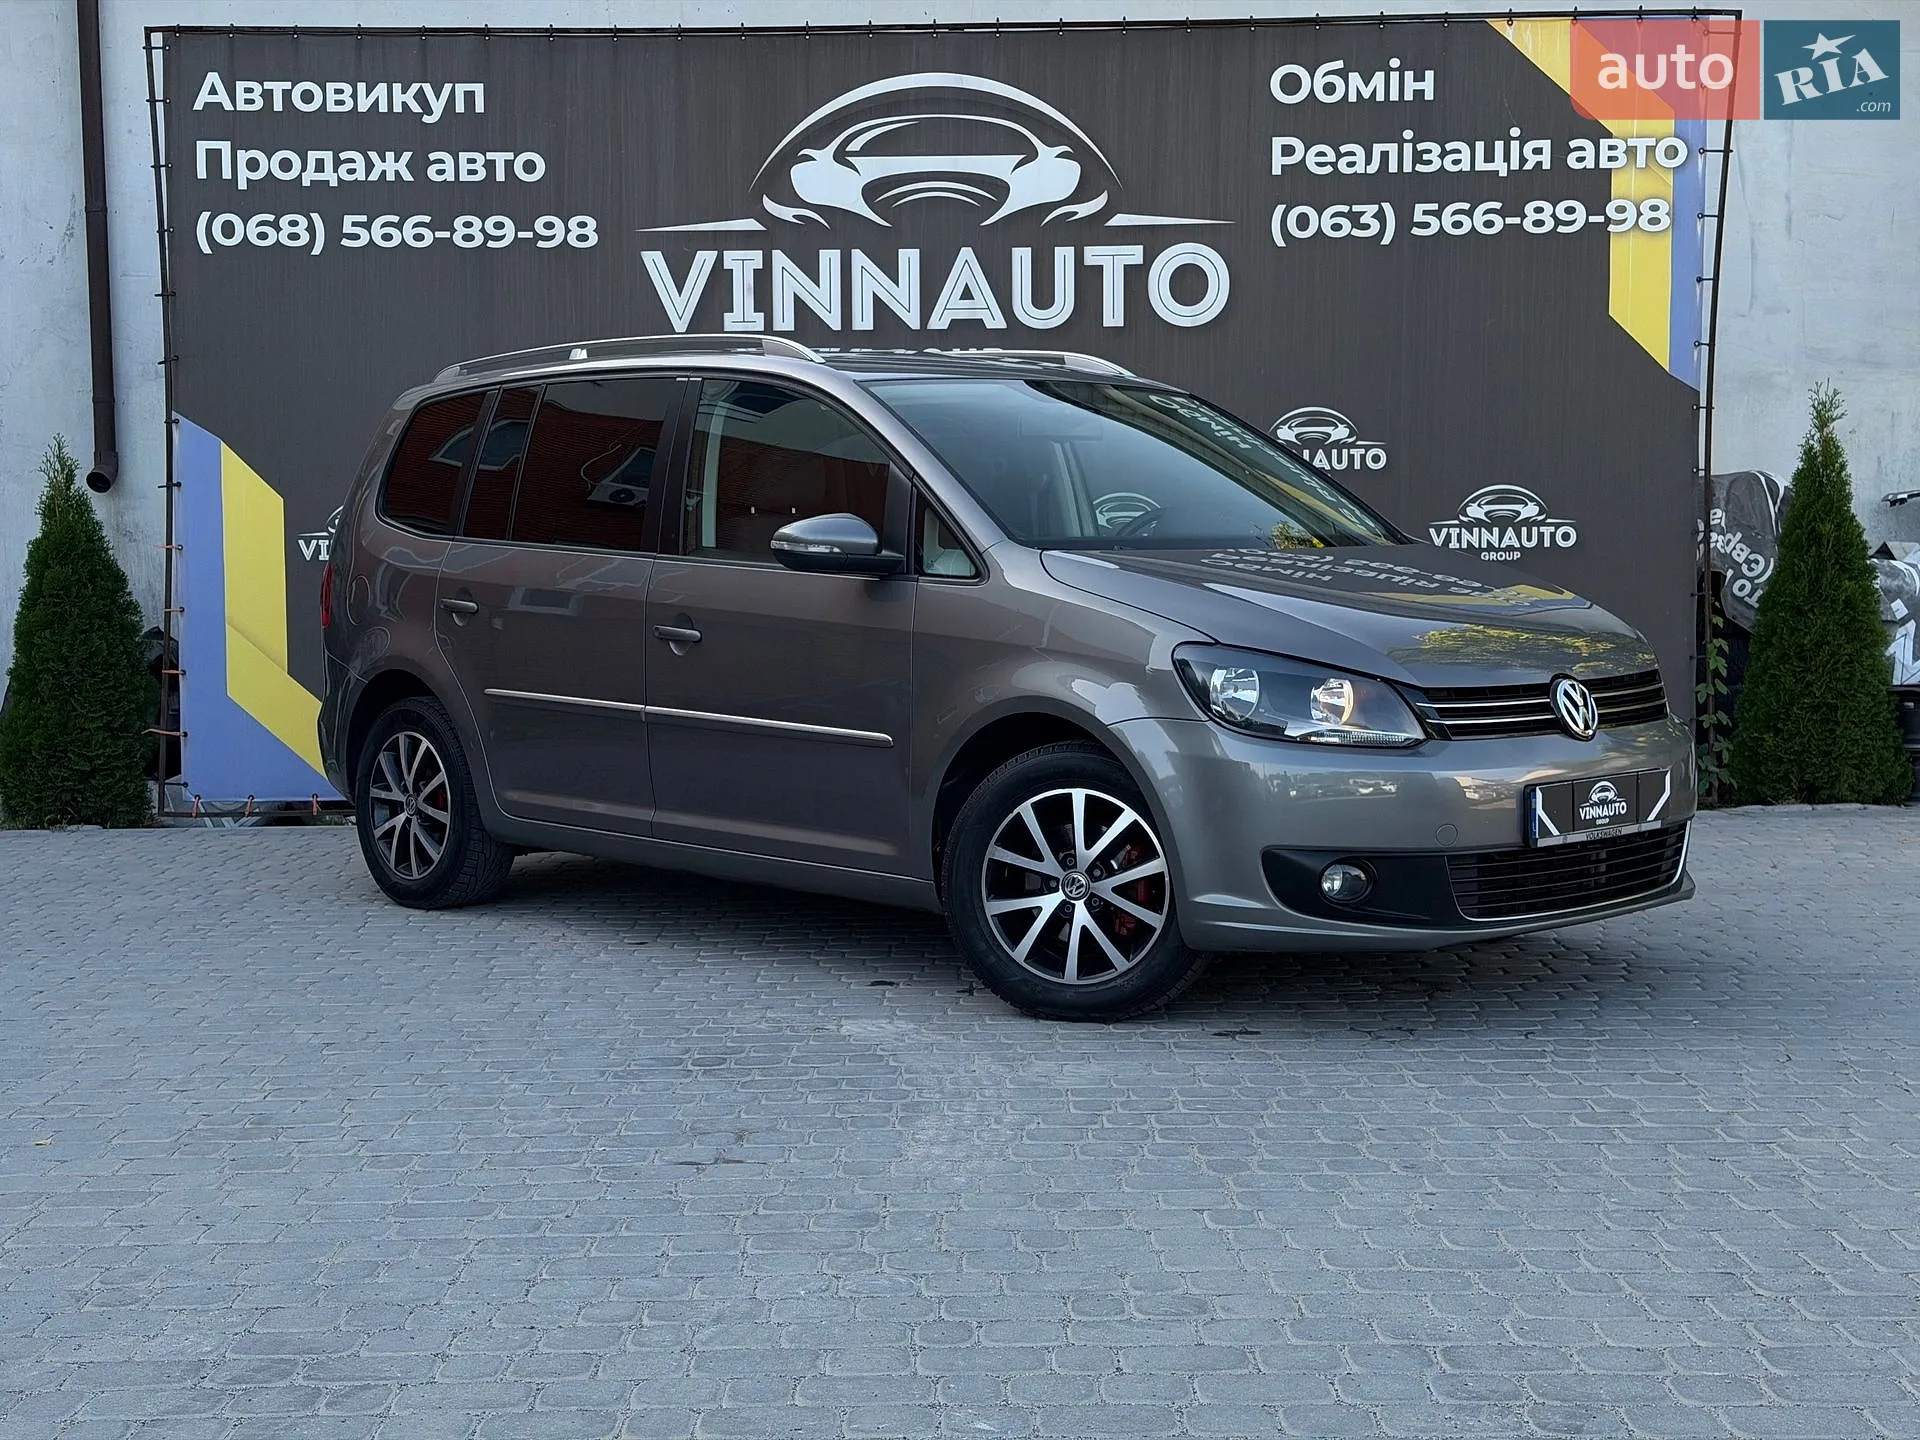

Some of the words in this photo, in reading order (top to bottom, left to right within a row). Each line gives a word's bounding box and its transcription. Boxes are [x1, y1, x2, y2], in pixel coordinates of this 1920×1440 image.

[192, 71, 486, 124] Автовикуп
[1269, 57, 1435, 104] Обмін
[195, 140, 414, 190] Продаж
[427, 150, 546, 182] авто
[1270, 127, 1552, 176] Реалізація
[1566, 134, 1689, 169] авто
[195, 211, 325, 255] (068)
[340, 214, 598, 249] 566-89-98
[1270, 203, 1395, 247] (063)
[1410, 199, 1672, 237] 566-89-98
[640, 242, 1231, 333] VINNAUTO
[297, 539, 332, 561] VI
[1429, 525, 1577, 549] VINNAUTO
[1480, 551, 1521, 561] GROUP
[1579, 801, 1628, 820] VINNAUTO
[1585, 827, 1623, 841] VOLKSWAGEN
